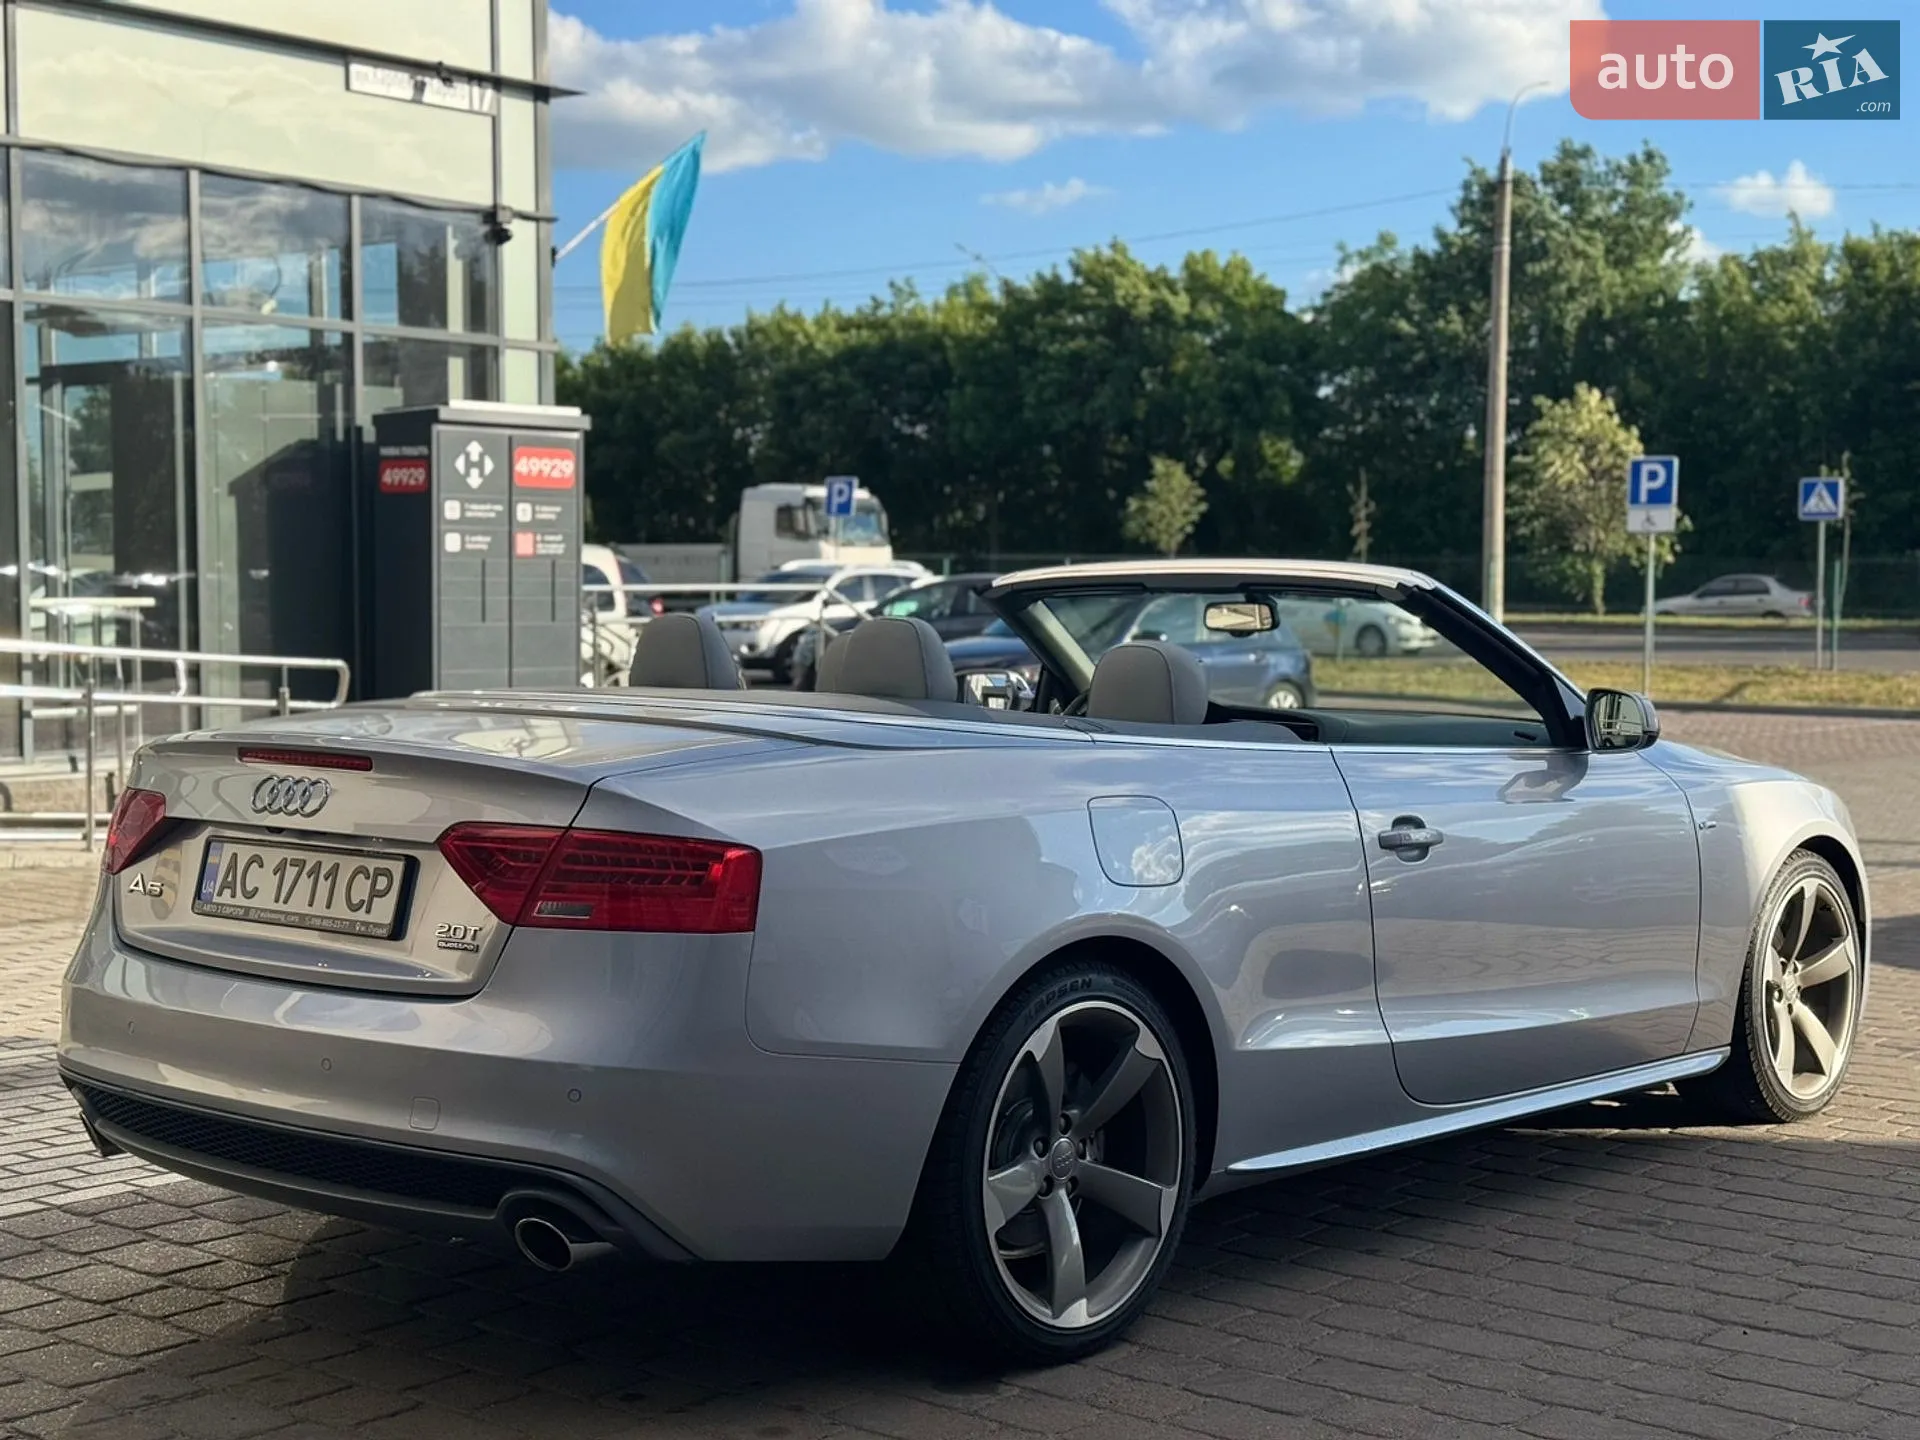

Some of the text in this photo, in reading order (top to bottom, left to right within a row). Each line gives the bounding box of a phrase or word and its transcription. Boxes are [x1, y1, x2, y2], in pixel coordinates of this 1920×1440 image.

[381, 467, 426, 486] 49929
[515, 456, 574, 479] 49929
[1639, 462, 1667, 504] P
[831, 482, 850, 514] P
[203, 879, 214, 894] UA
[216, 851, 395, 914] AC 1711 CP
